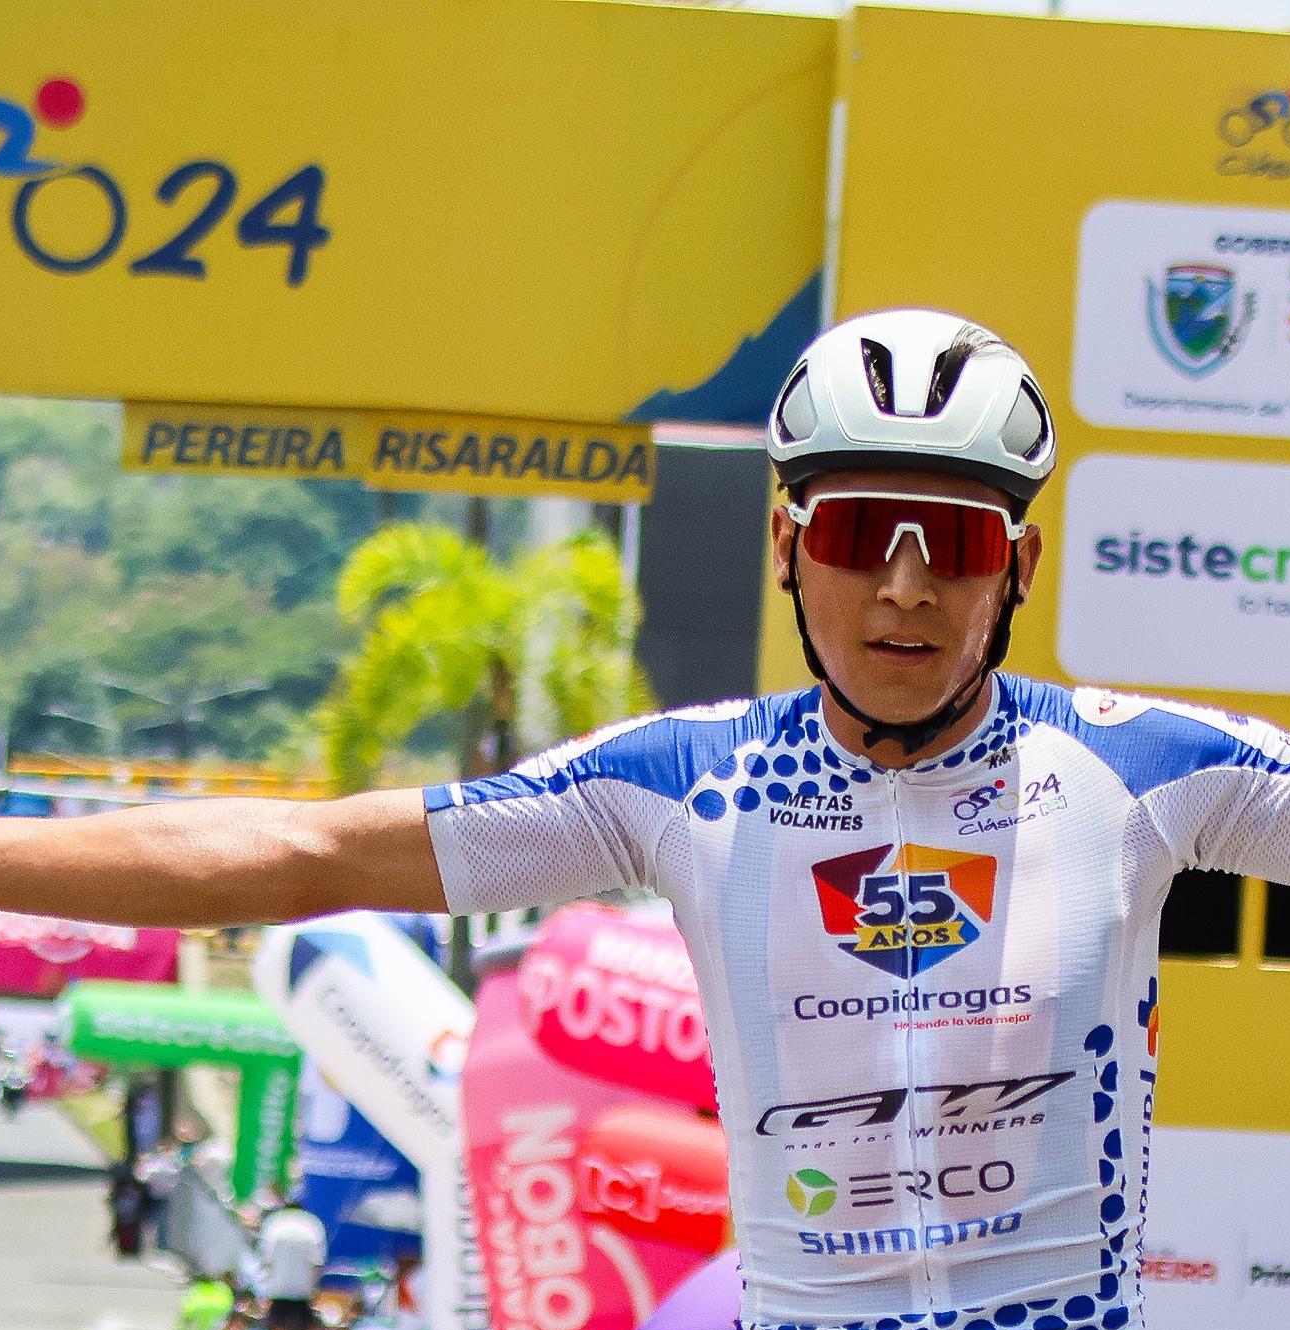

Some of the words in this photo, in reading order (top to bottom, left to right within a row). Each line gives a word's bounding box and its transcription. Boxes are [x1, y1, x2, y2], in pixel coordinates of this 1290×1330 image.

[128, 160, 330, 287] 24
[141, 420, 345, 471] PEREIRA
[371, 427, 650, 487] RISARALDA
[769, 808, 864, 831] VOLANTES
[783, 793, 853, 811] METAS
[959, 813, 1037, 836] Clásico
[859, 874, 956, 926] 55
[869, 924, 951, 949] AÑOS
[794, 983, 1032, 1021] Coopidrogas
[909, 1112, 1046, 1139] WINNERS
[849, 1160, 1016, 1208] ERCO
[798, 1210, 1023, 1256] SHIMANO
